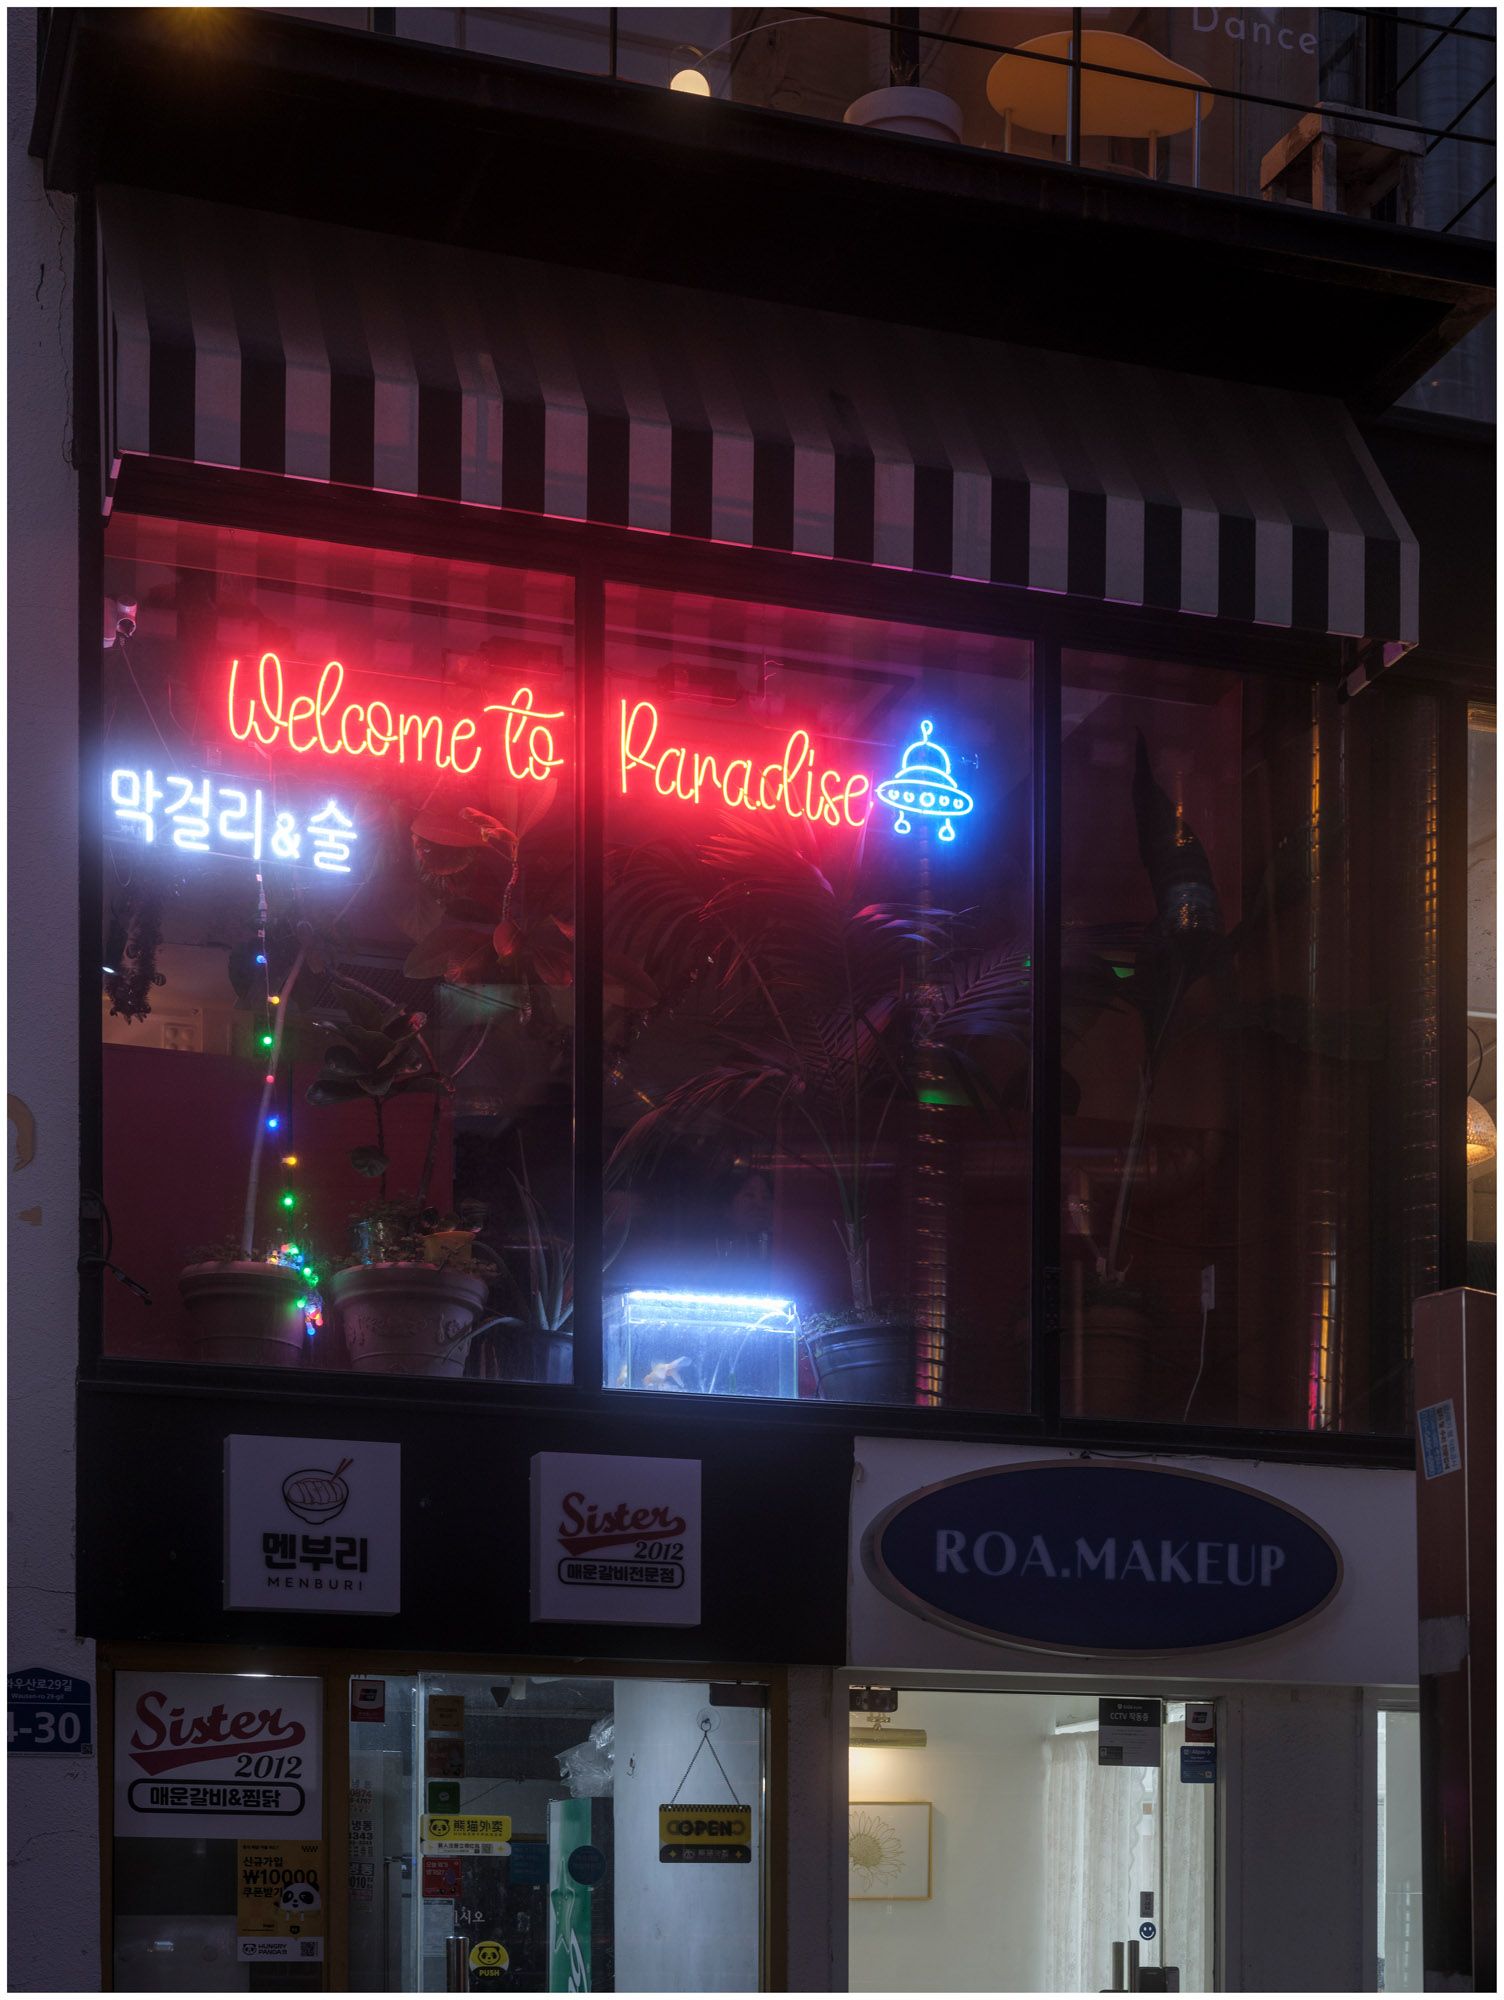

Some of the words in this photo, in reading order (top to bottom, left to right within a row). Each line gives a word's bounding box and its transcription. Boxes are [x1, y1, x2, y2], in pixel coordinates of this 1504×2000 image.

[1192, 7, 1318, 54] Dance
[227, 652, 482, 774] Welcome
[483, 687, 565, 780] to
[620, 699, 869, 827] Paradise
[110, 768, 358, 873] 막걸리&술
[558, 1490, 687, 1538] Sister
[262, 1532, 369, 1573] 멘부리
[633, 1539, 685, 1561] 2012
[935, 1529, 1287, 1588] ROA.MAKEUP
[267, 1576, 364, 1591] MENBURI
[566, 1562, 676, 1585] 매운갈비전문점
[130, 1690, 306, 1751] Sister
[1110, 1712, 1127, 1721] CCTV
[235, 1753, 303, 1779] 2012
[150, 1786, 281, 1809] 매운갈비&찜닭
[453, 1820, 503, 1833] 熊猫外卖
[678, 1820, 732, 1836] OPEN
[243, 1856, 283, 1867] 신규가입
[478, 1969, 501, 1977] PUSH
